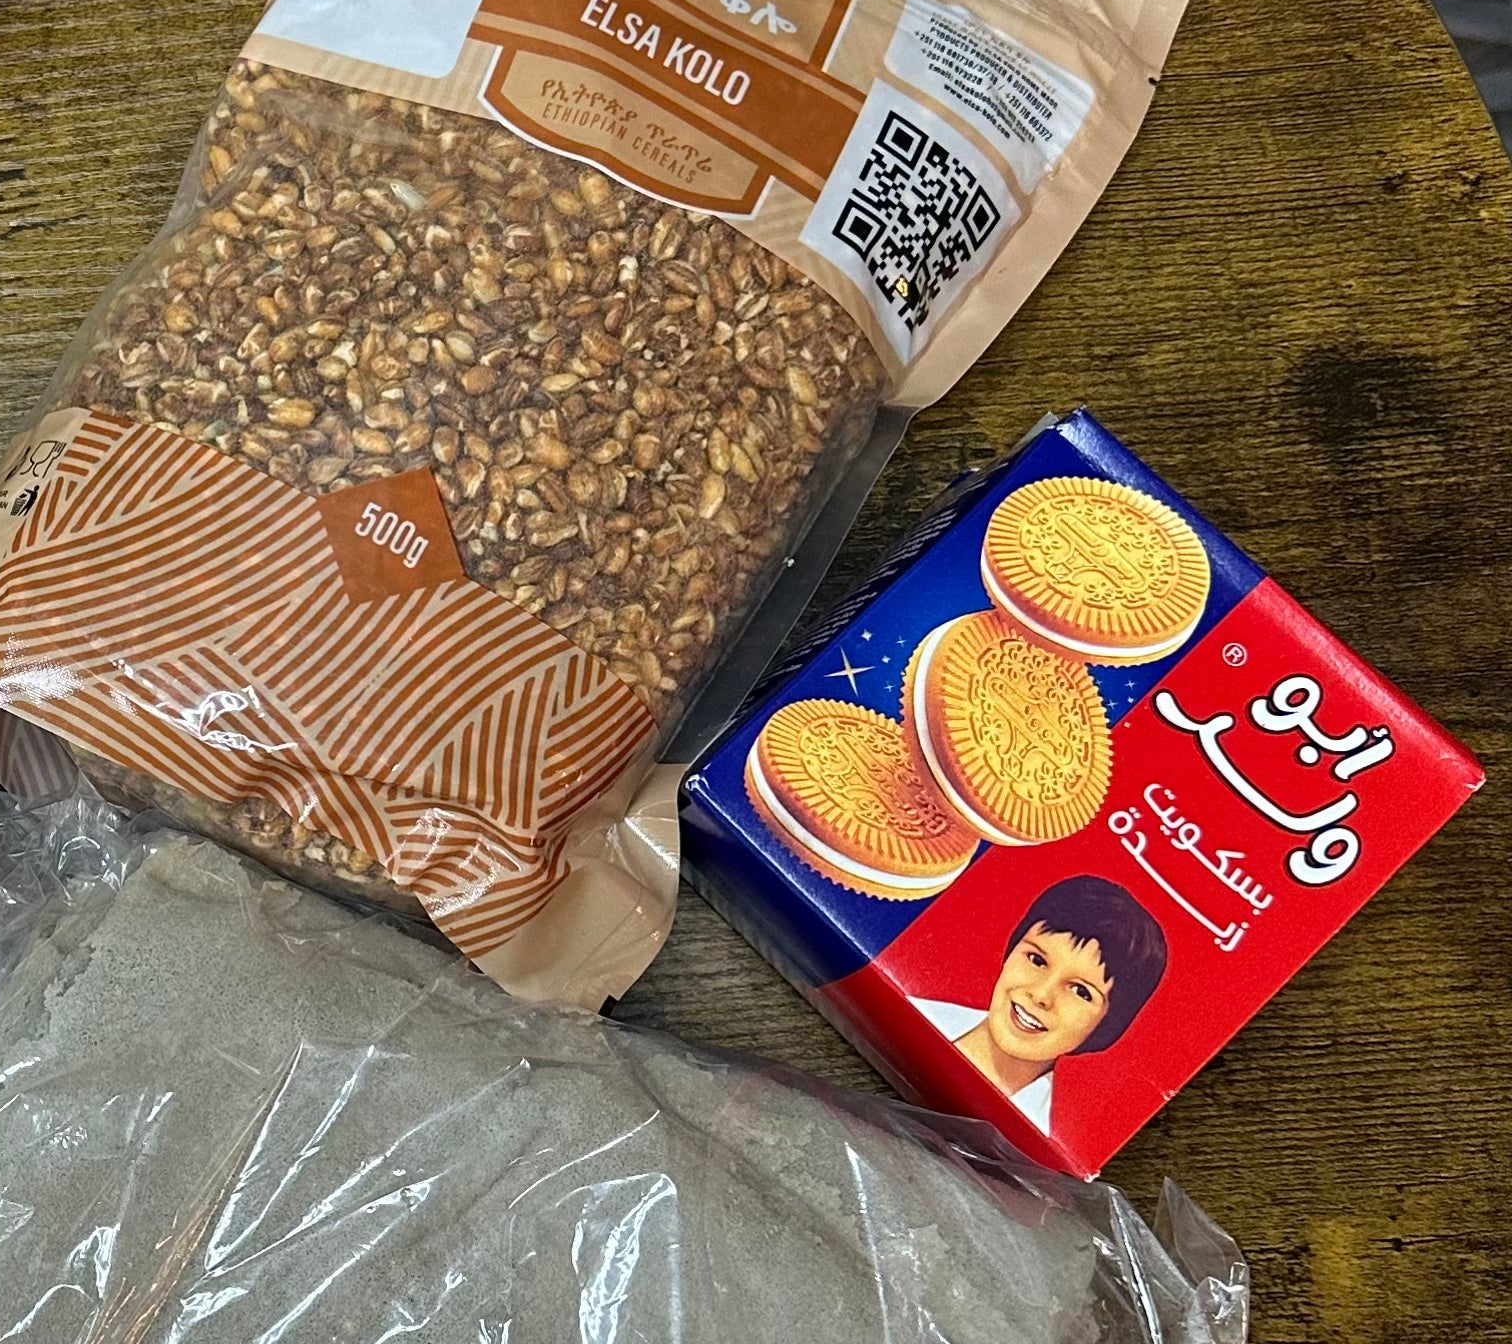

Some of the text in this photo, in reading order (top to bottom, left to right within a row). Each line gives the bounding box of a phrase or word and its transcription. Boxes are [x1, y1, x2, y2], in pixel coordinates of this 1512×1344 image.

[662, 36, 751, 107] KOLO
[542, 102, 698, 185] ETHIOPIAN CEREALS
[352, 500, 433, 573] 500g
[1250, 675, 1395, 783] أبو
[1107, 806, 1250, 953] زبدة
[1143, 782, 1275, 916] بسكويت
